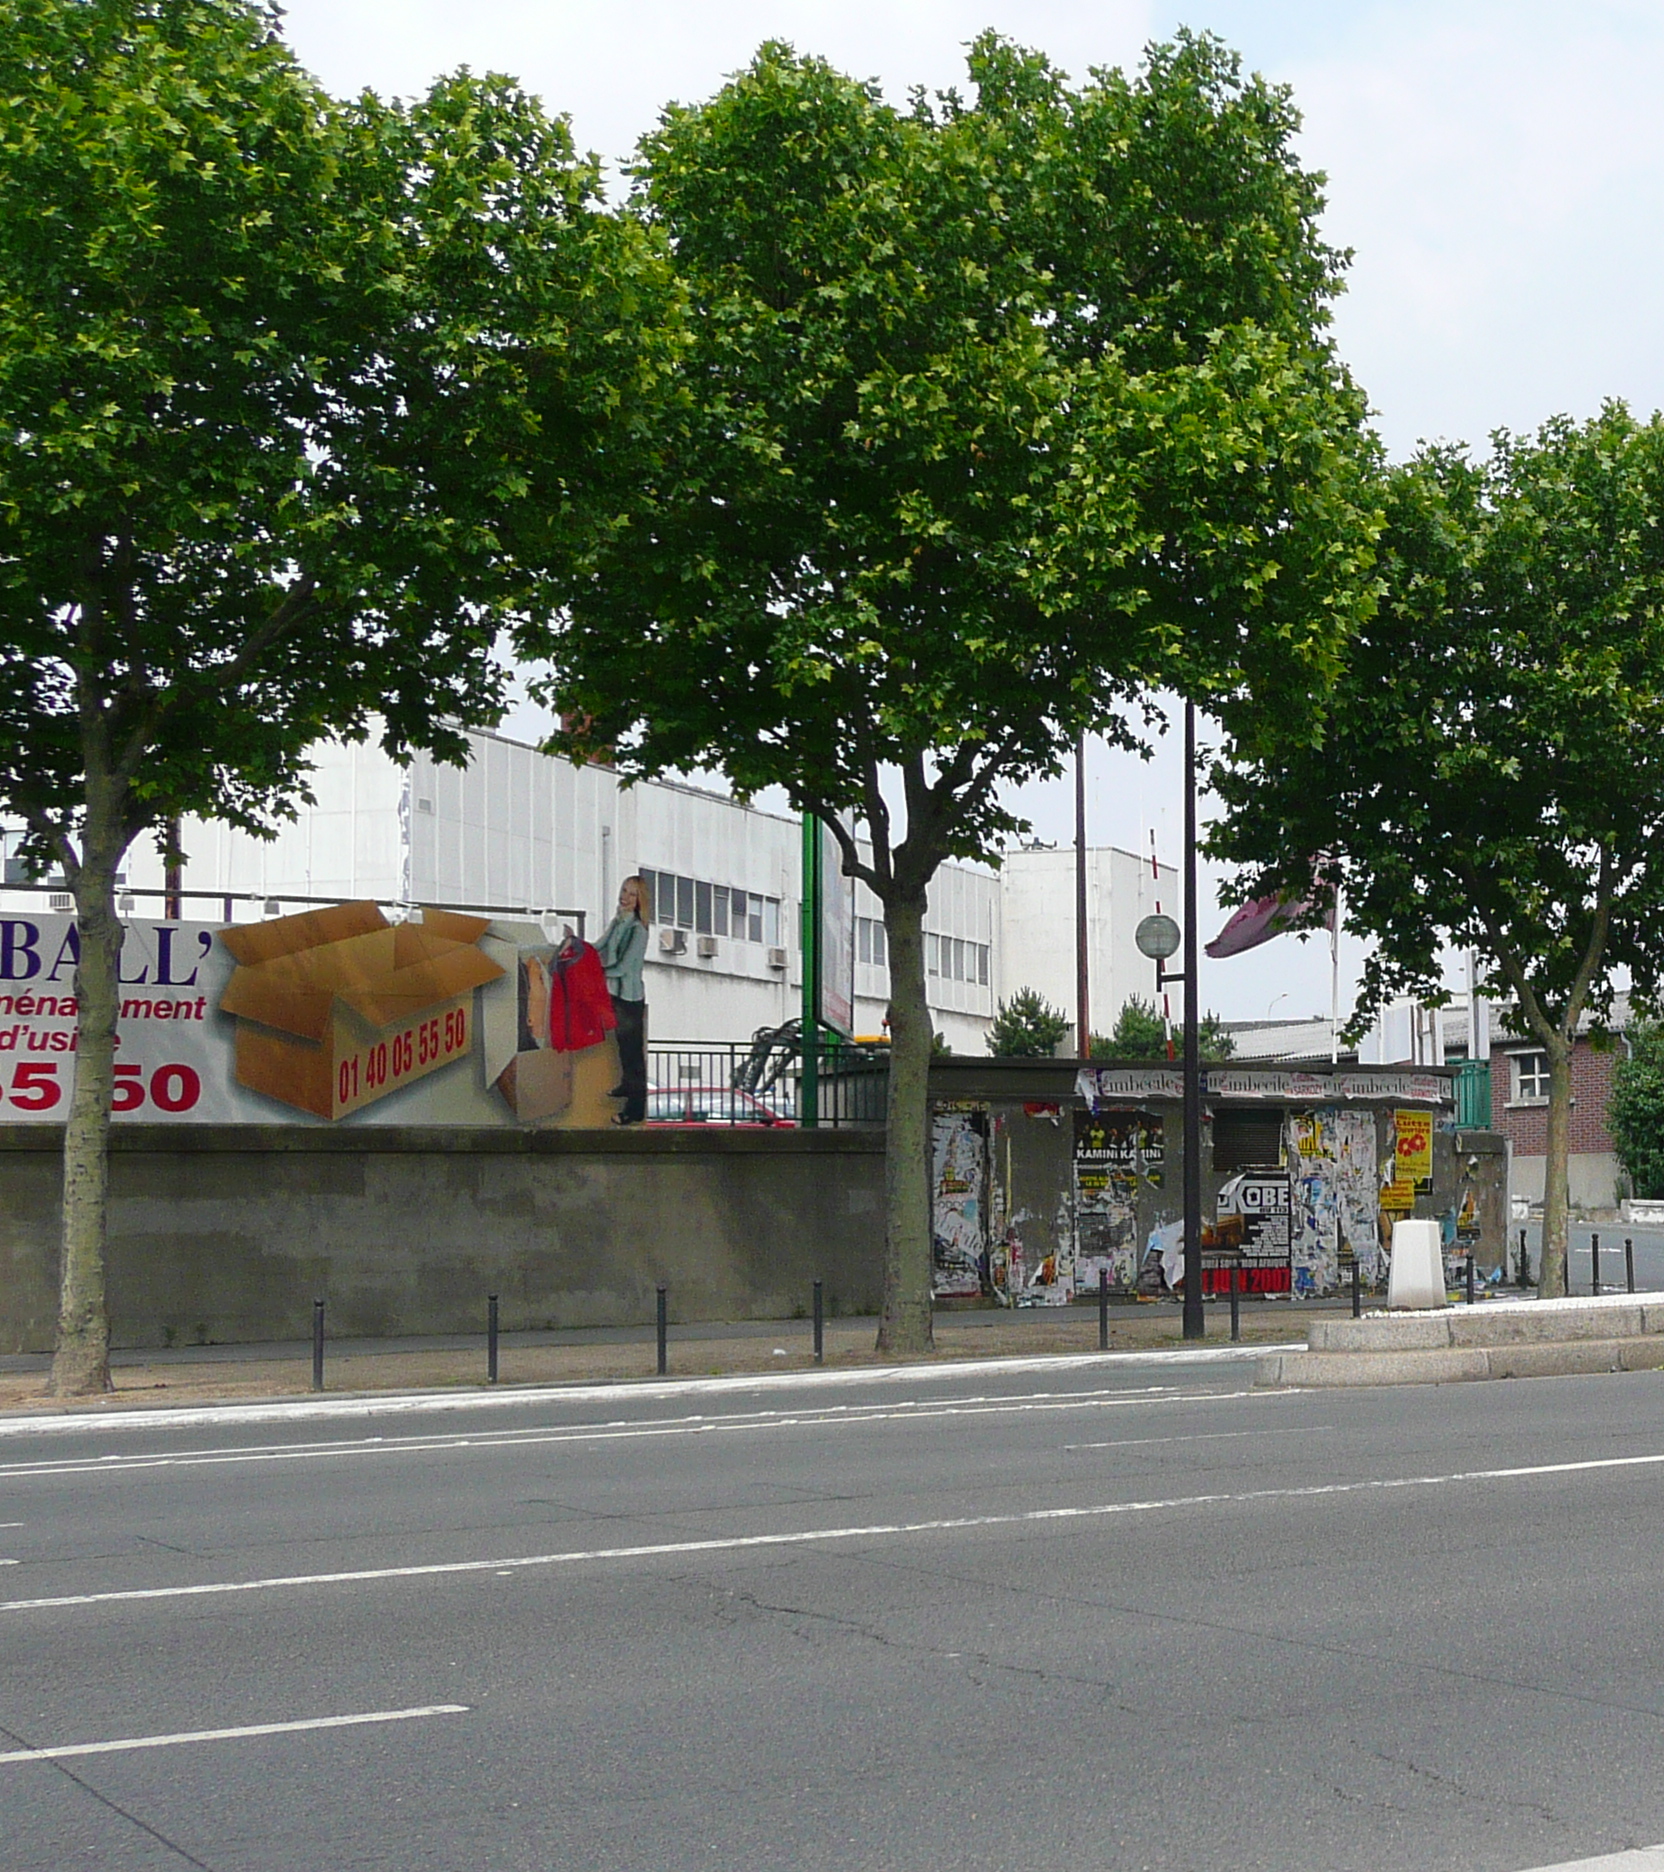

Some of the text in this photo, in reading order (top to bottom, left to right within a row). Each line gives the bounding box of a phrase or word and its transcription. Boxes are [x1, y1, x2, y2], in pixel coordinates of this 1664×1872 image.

[0, 988, 206, 1020] énament
[340, 1008, 465, 1104] 01 40 05 55 50
[111, 1064, 200, 1112] 50
[1251, 1269, 1290, 1292] 2007
